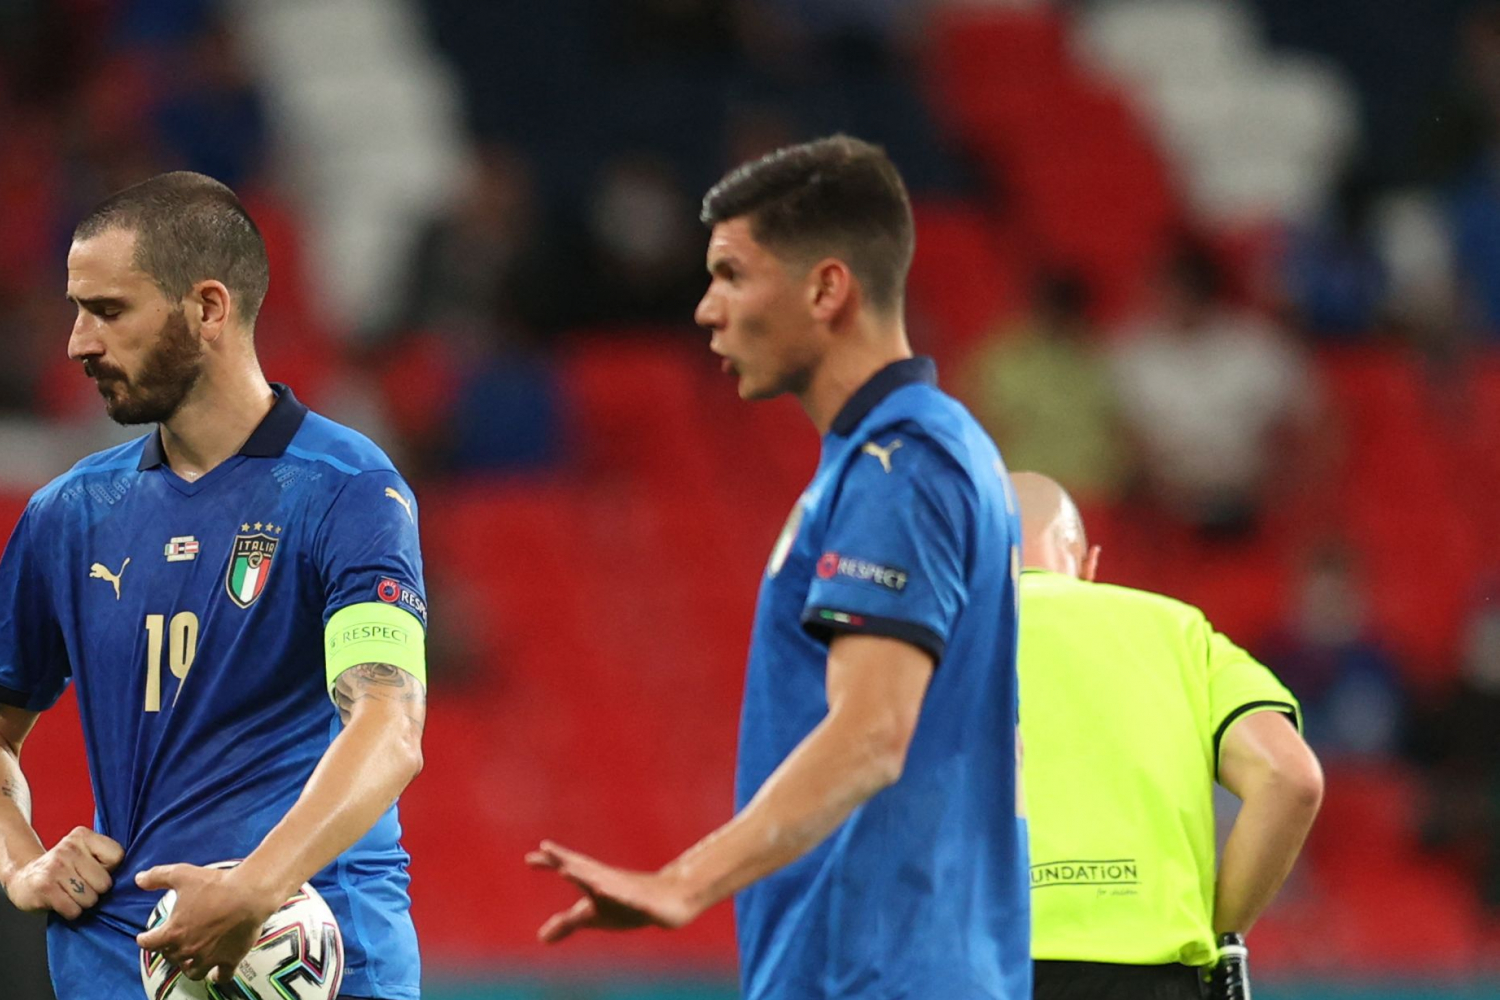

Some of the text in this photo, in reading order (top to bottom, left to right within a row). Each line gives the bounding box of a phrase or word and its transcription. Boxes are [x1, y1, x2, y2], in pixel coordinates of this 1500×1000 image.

[238, 540, 275, 553] ITALIA
[838, 557, 907, 591] RESPECT
[342, 626, 408, 643] RESPECT
[144, 611, 199, 713] 19
